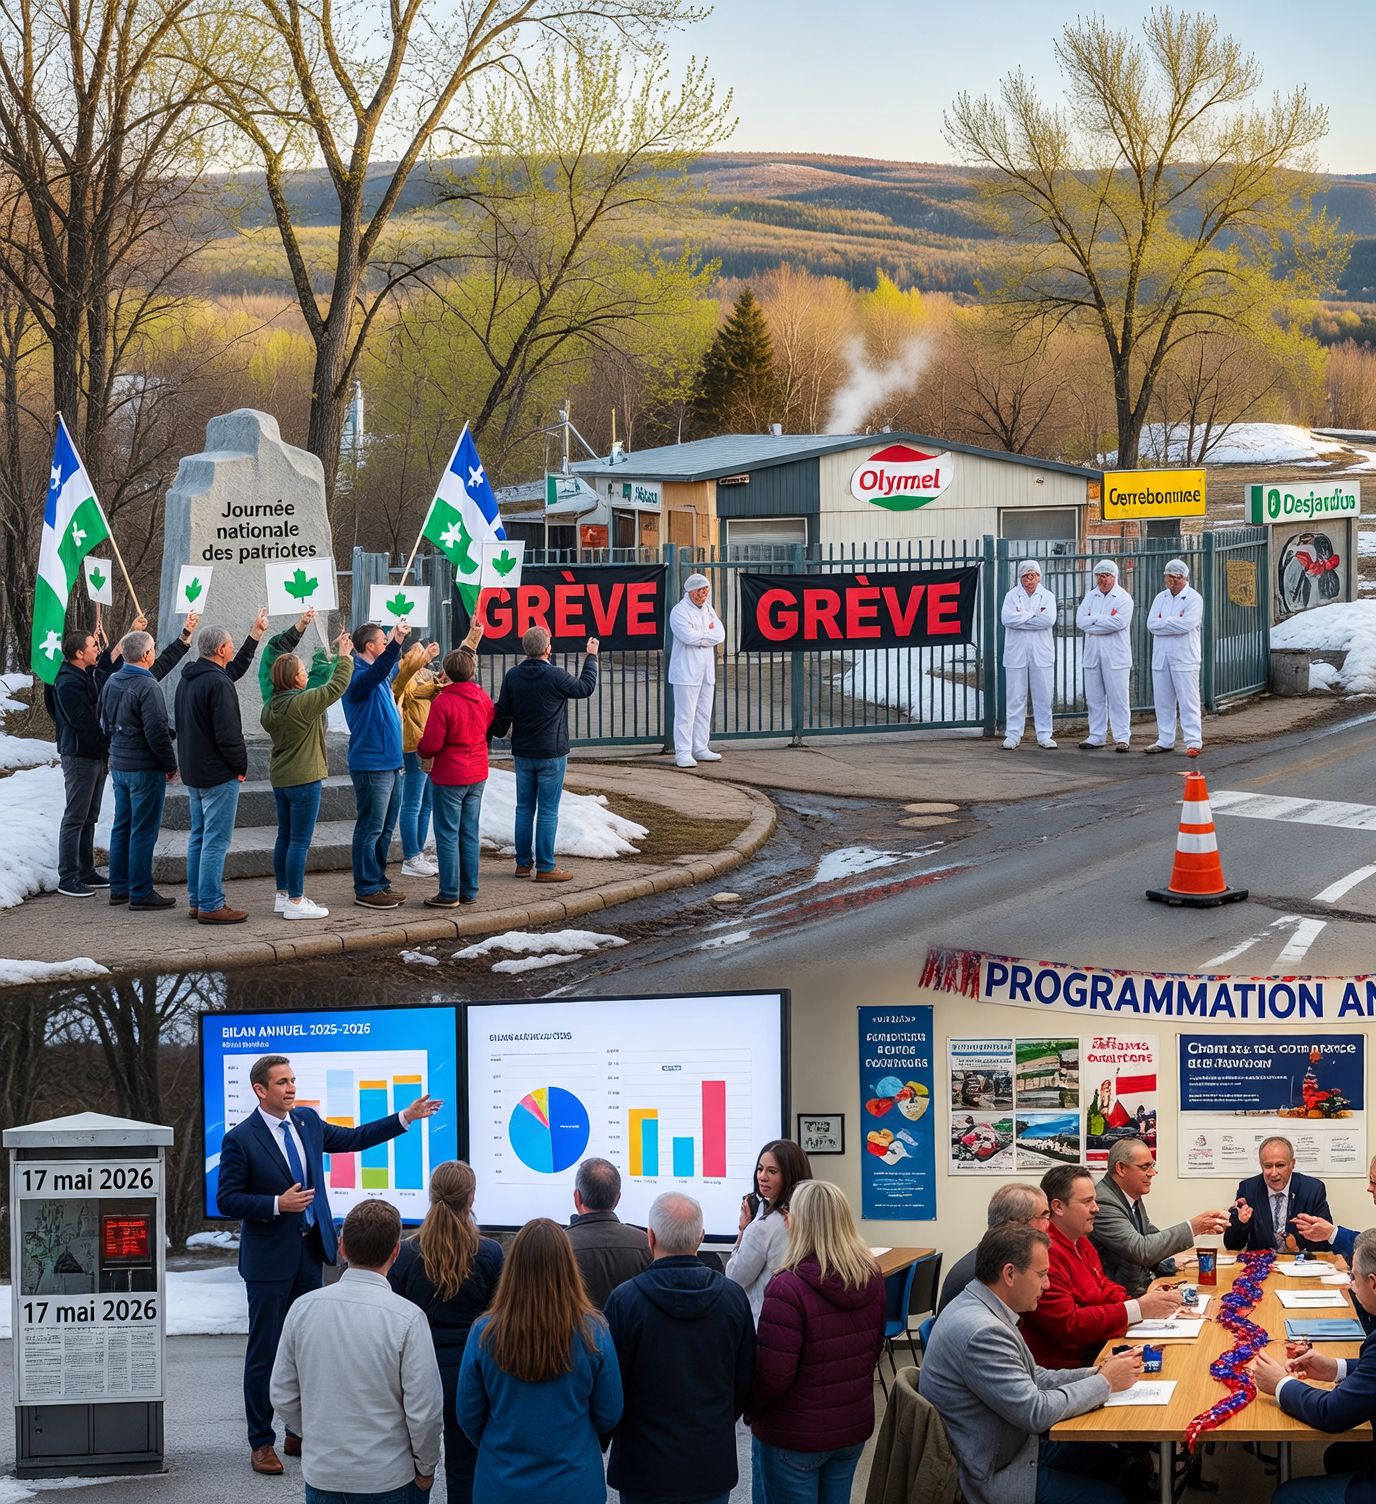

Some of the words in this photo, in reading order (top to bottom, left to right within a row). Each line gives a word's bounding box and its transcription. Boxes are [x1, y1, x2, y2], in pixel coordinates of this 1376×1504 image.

[221, 499, 295, 517] Journée
[217, 520, 299, 539] nationale
[202, 544, 233, 561] des
[239, 542, 316, 564] patriotes
[476, 570, 657, 640] GRÈVE
[756, 575, 961, 642] GRÈVE
[985, 962, 1324, 1019] PROGRAMMATION
[222, 1027, 256, 1038] BILAN
[258, 1025, 307, 1037] ANNUEL
[22, 1169, 48, 1191] 17
[53, 1168, 93, 1191] mai
[99, 1168, 154, 1190] 2026
[23, 1302, 49, 1324] 17
[56, 1300, 95, 1323] mai
[102, 1299, 158, 1321] 2026
